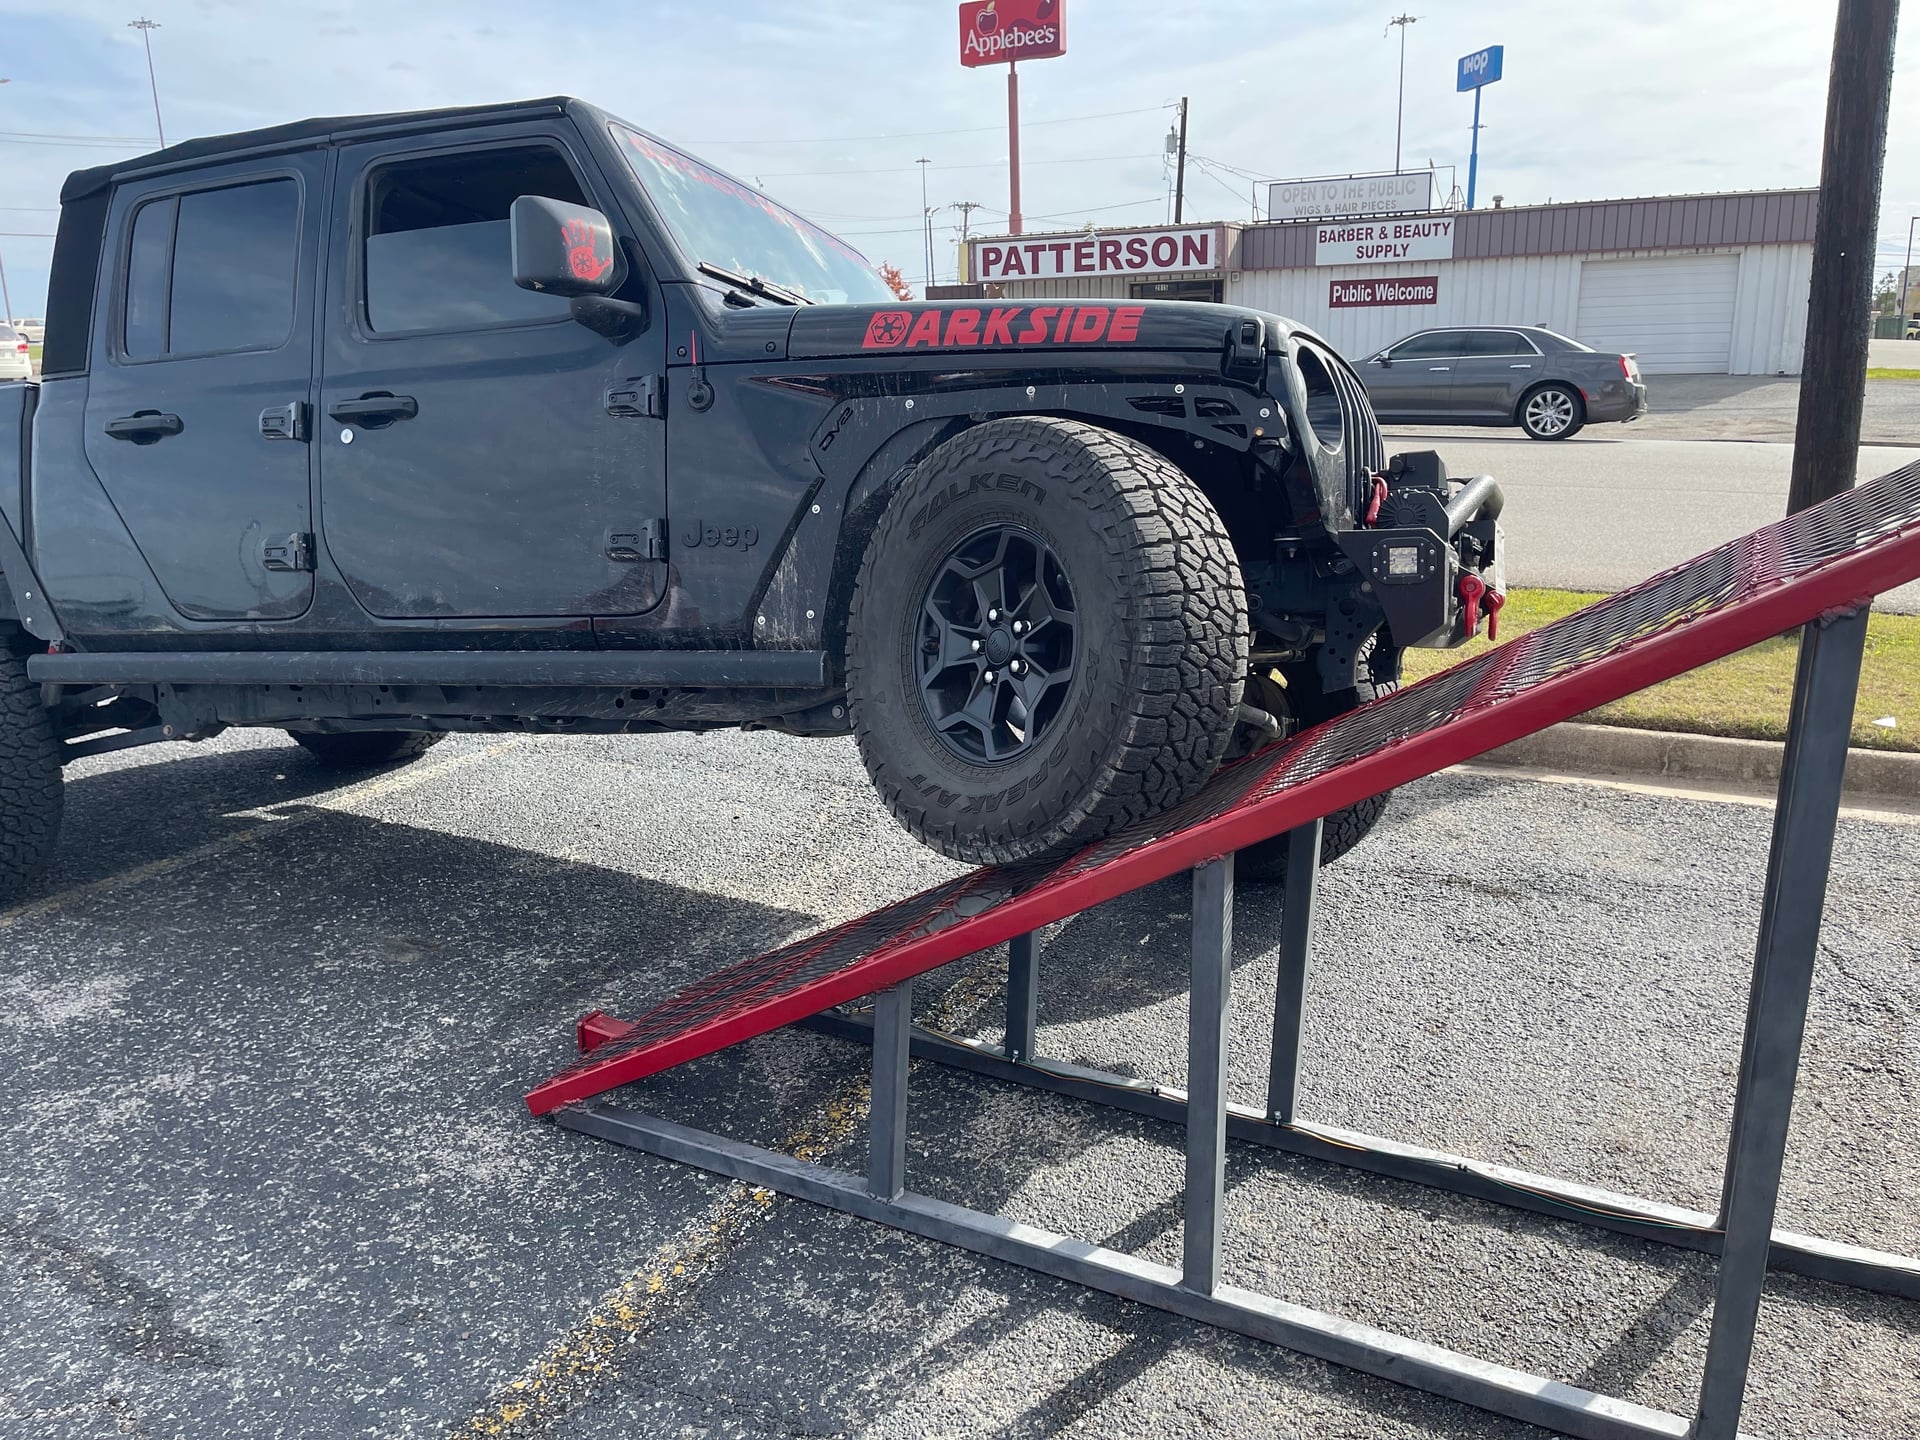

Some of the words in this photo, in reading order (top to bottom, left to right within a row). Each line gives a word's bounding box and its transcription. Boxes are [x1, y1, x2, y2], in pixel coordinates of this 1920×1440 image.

[964, 25, 1055, 56] Applebee's
[1463, 51, 1488, 75] IHOP
[1282, 186, 1316, 203] OPEN
[1321, 184, 1337, 200] TO
[1343, 183, 1364, 199] THE
[1369, 179, 1417, 197] PUBLIC
[1294, 205, 1321, 216] WIGS
[1324, 204, 1331, 214] &
[1335, 202, 1358, 213] HAIR
[1361, 200, 1397, 211] PIECES
[1319, 227, 1374, 244] BARBER
[1379, 225, 1388, 240] &
[1393, 222, 1451, 239] BEAUTY
[982, 233, 1209, 277] PATTERSON
[1356, 243, 1410, 259] SUPPLY
[1333, 284, 1372, 303] Public
[1375, 283, 1434, 301] Welcome
[906, 471, 1047, 542] FALKEN
[682, 518, 759, 552] Jeep
